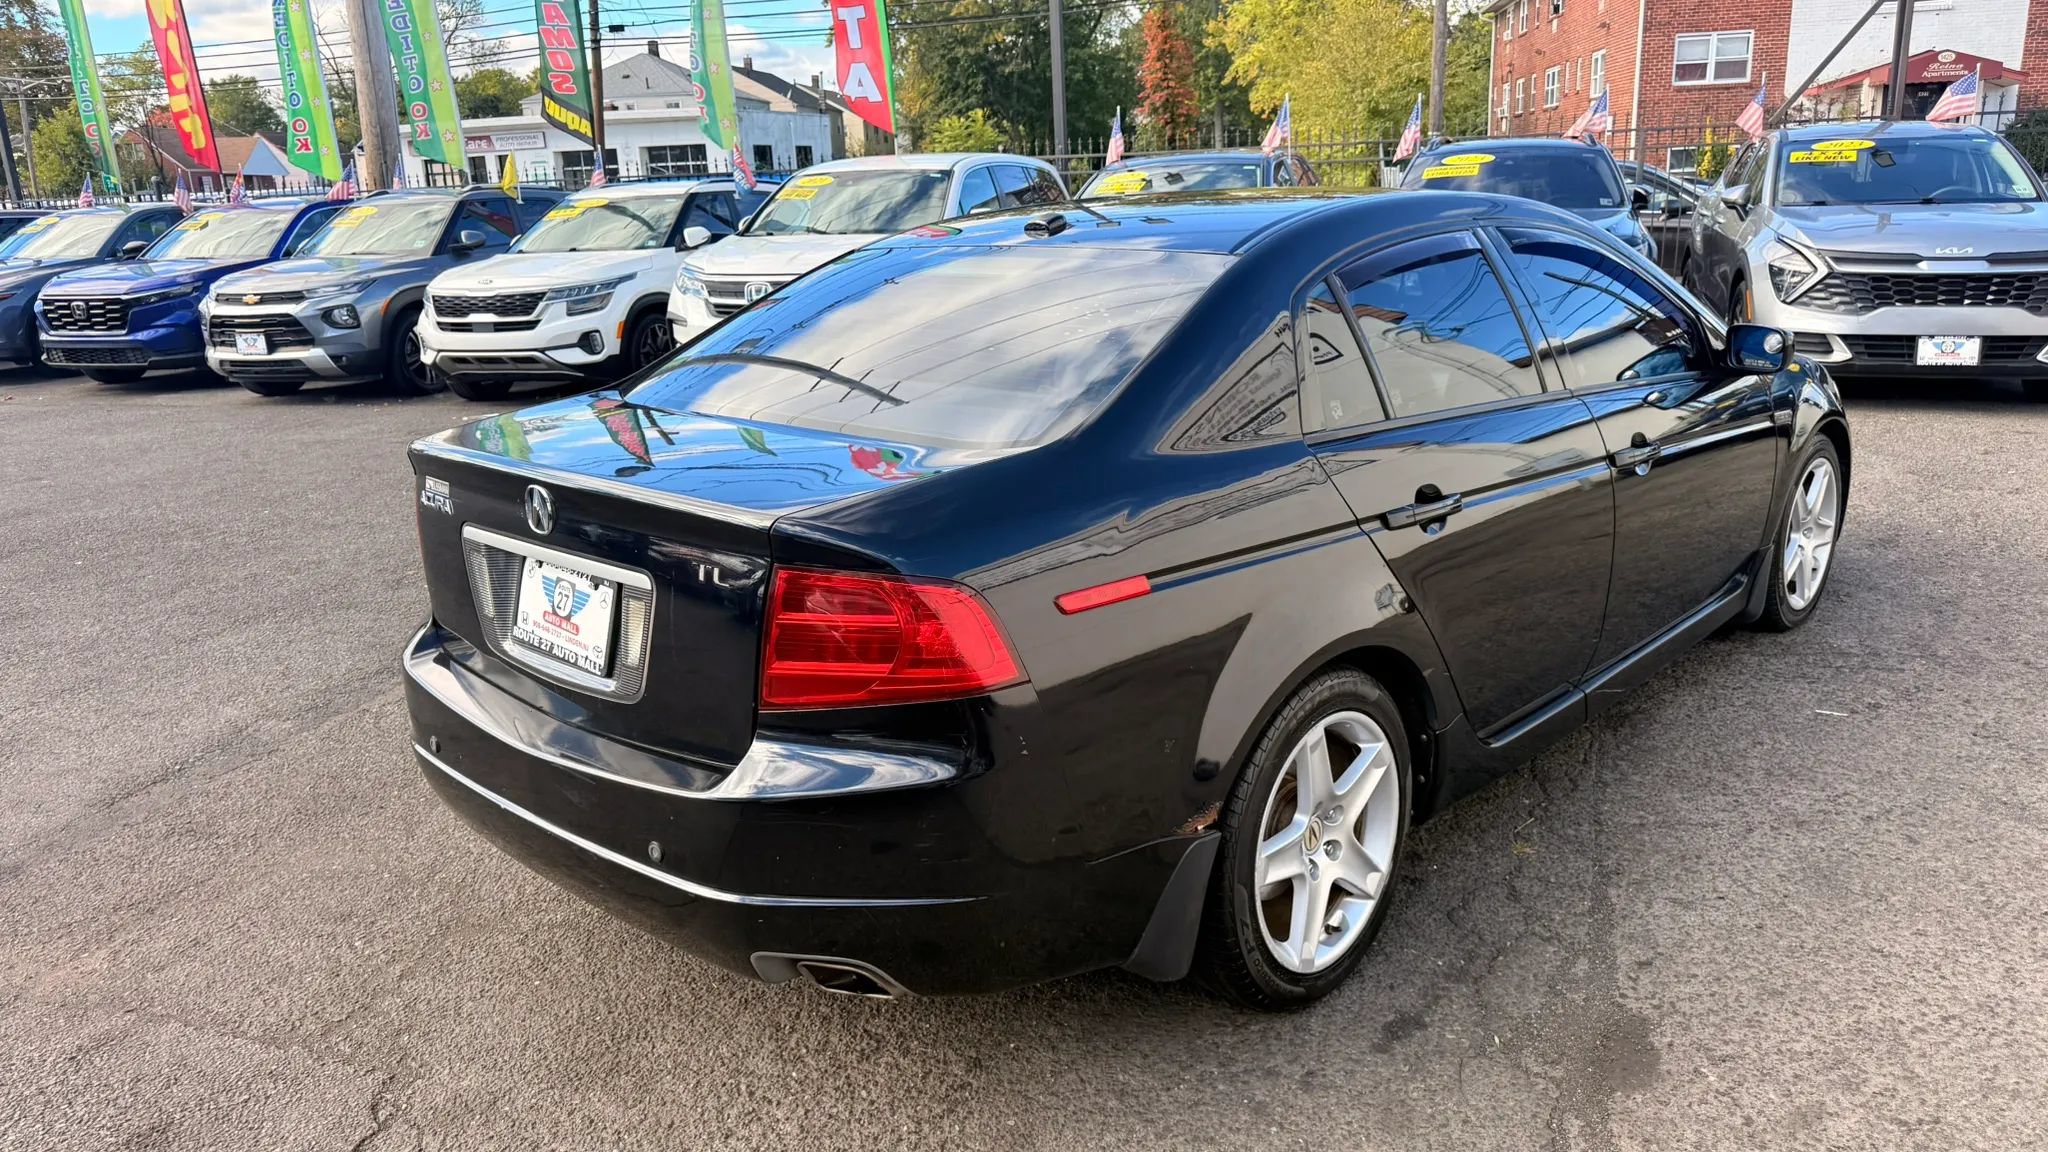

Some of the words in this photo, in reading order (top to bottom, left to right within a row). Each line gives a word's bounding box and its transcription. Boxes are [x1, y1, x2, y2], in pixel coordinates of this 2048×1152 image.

[836, 5, 884, 103] TA
[1921, 69, 1969, 77] Apartments
[495, 134, 540, 143] PROFESSIONAL
[691, 562, 730, 587] TL
[556, 592, 570, 612] 27
[544, 613, 560, 626] AUTO
[561, 619, 579, 634] MALL
[512, 626, 541, 648] ROUTE
[541, 637, 552, 651] 27
[552, 644, 576, 662] AUTO
[577, 654, 602, 676] MALL
